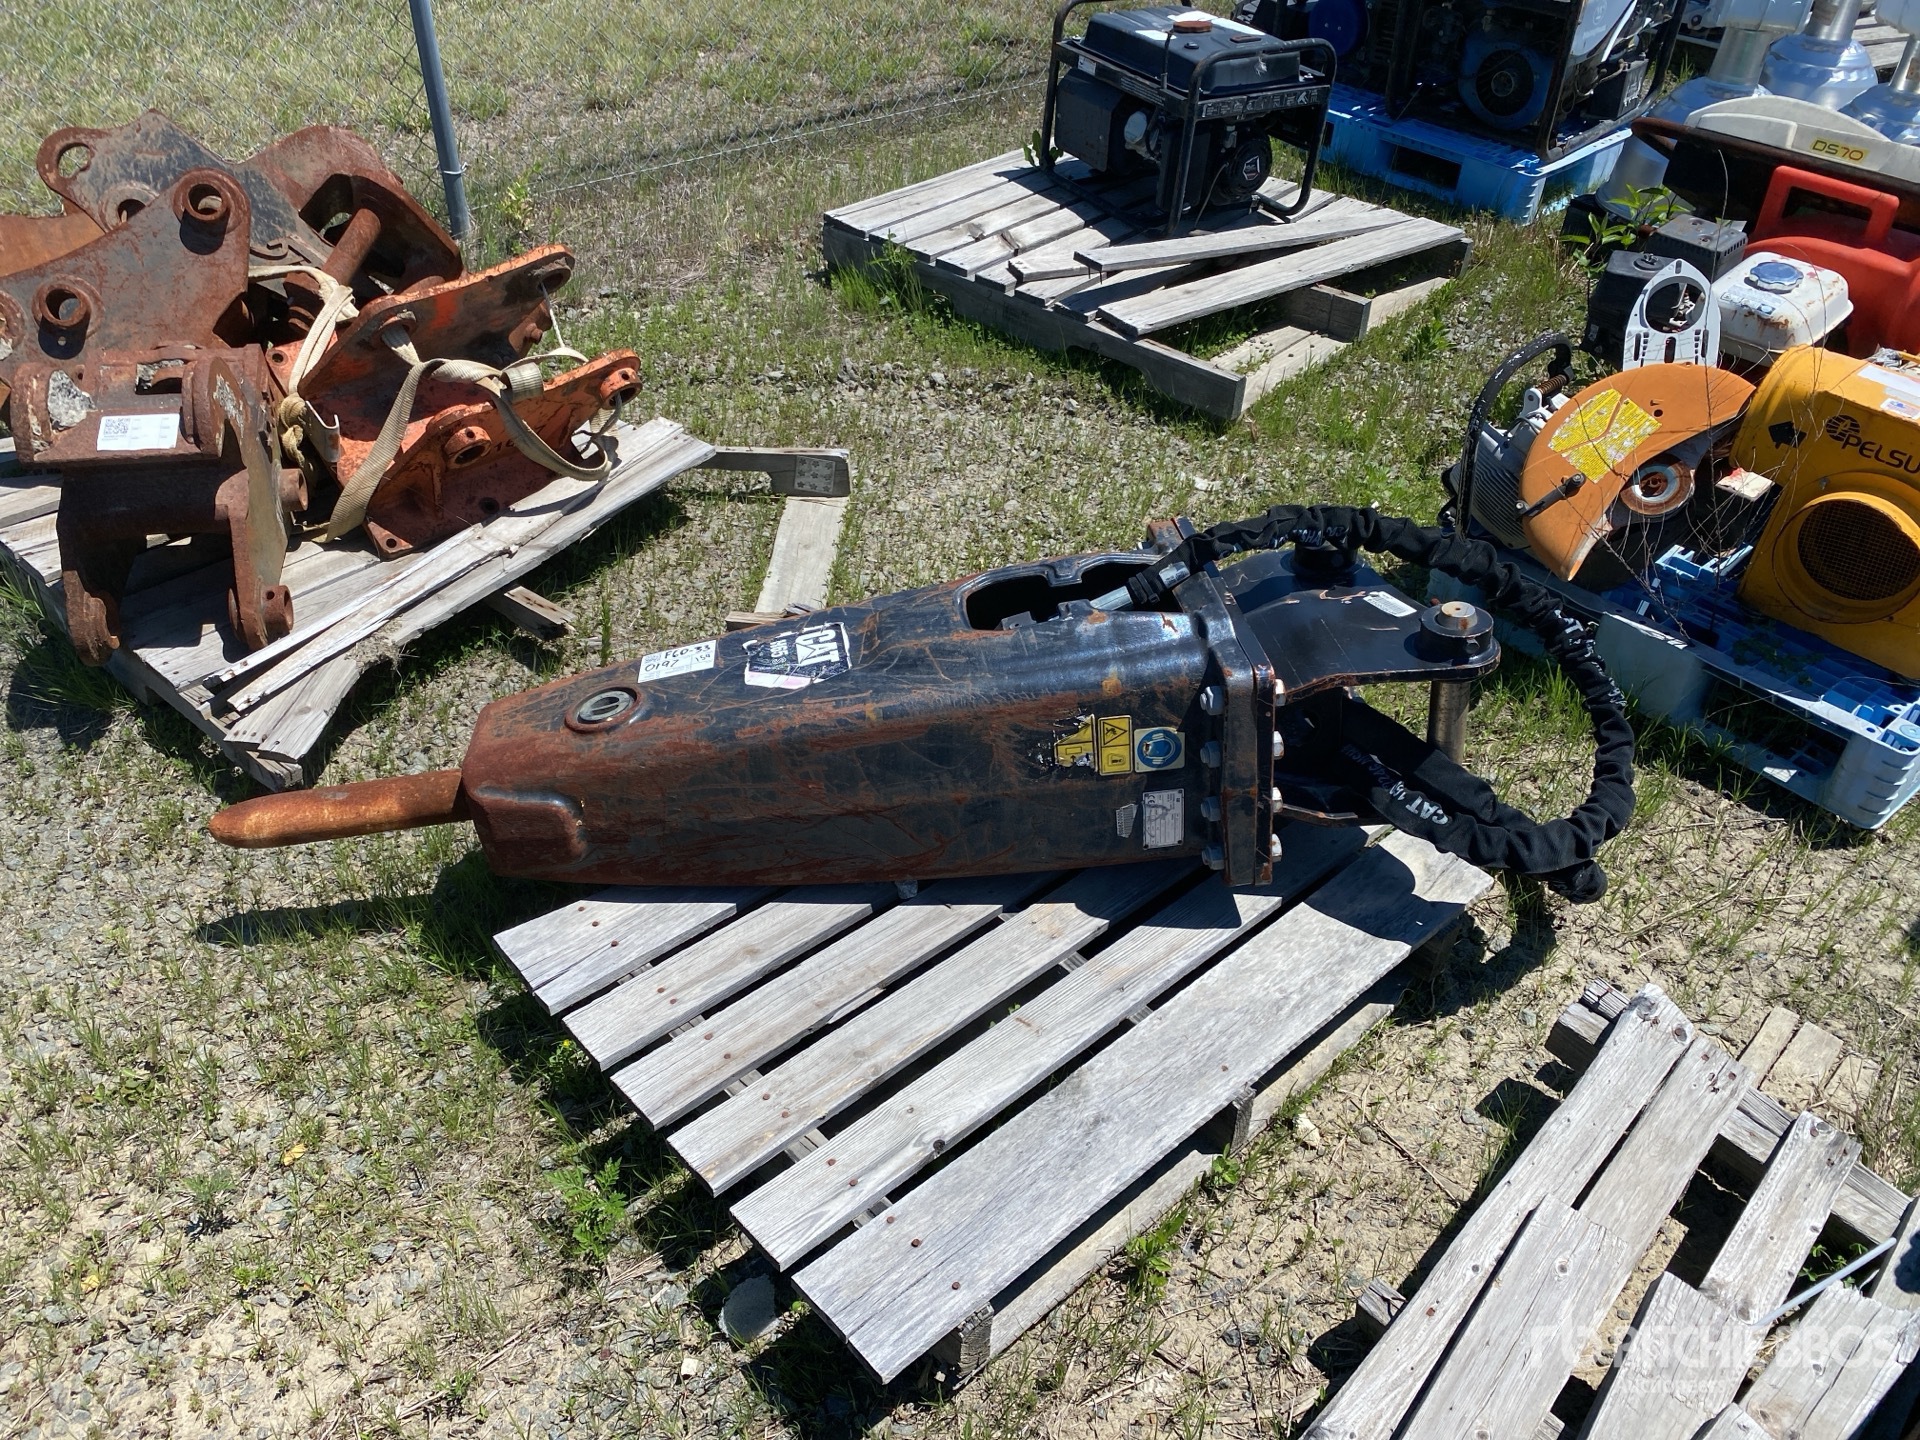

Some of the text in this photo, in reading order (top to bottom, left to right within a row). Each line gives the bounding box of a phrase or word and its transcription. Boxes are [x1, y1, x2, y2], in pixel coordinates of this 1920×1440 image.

[1812, 140, 1864, 161] DS70
[796, 629, 840, 667] CAT
[1405, 796, 1449, 825] CAT
